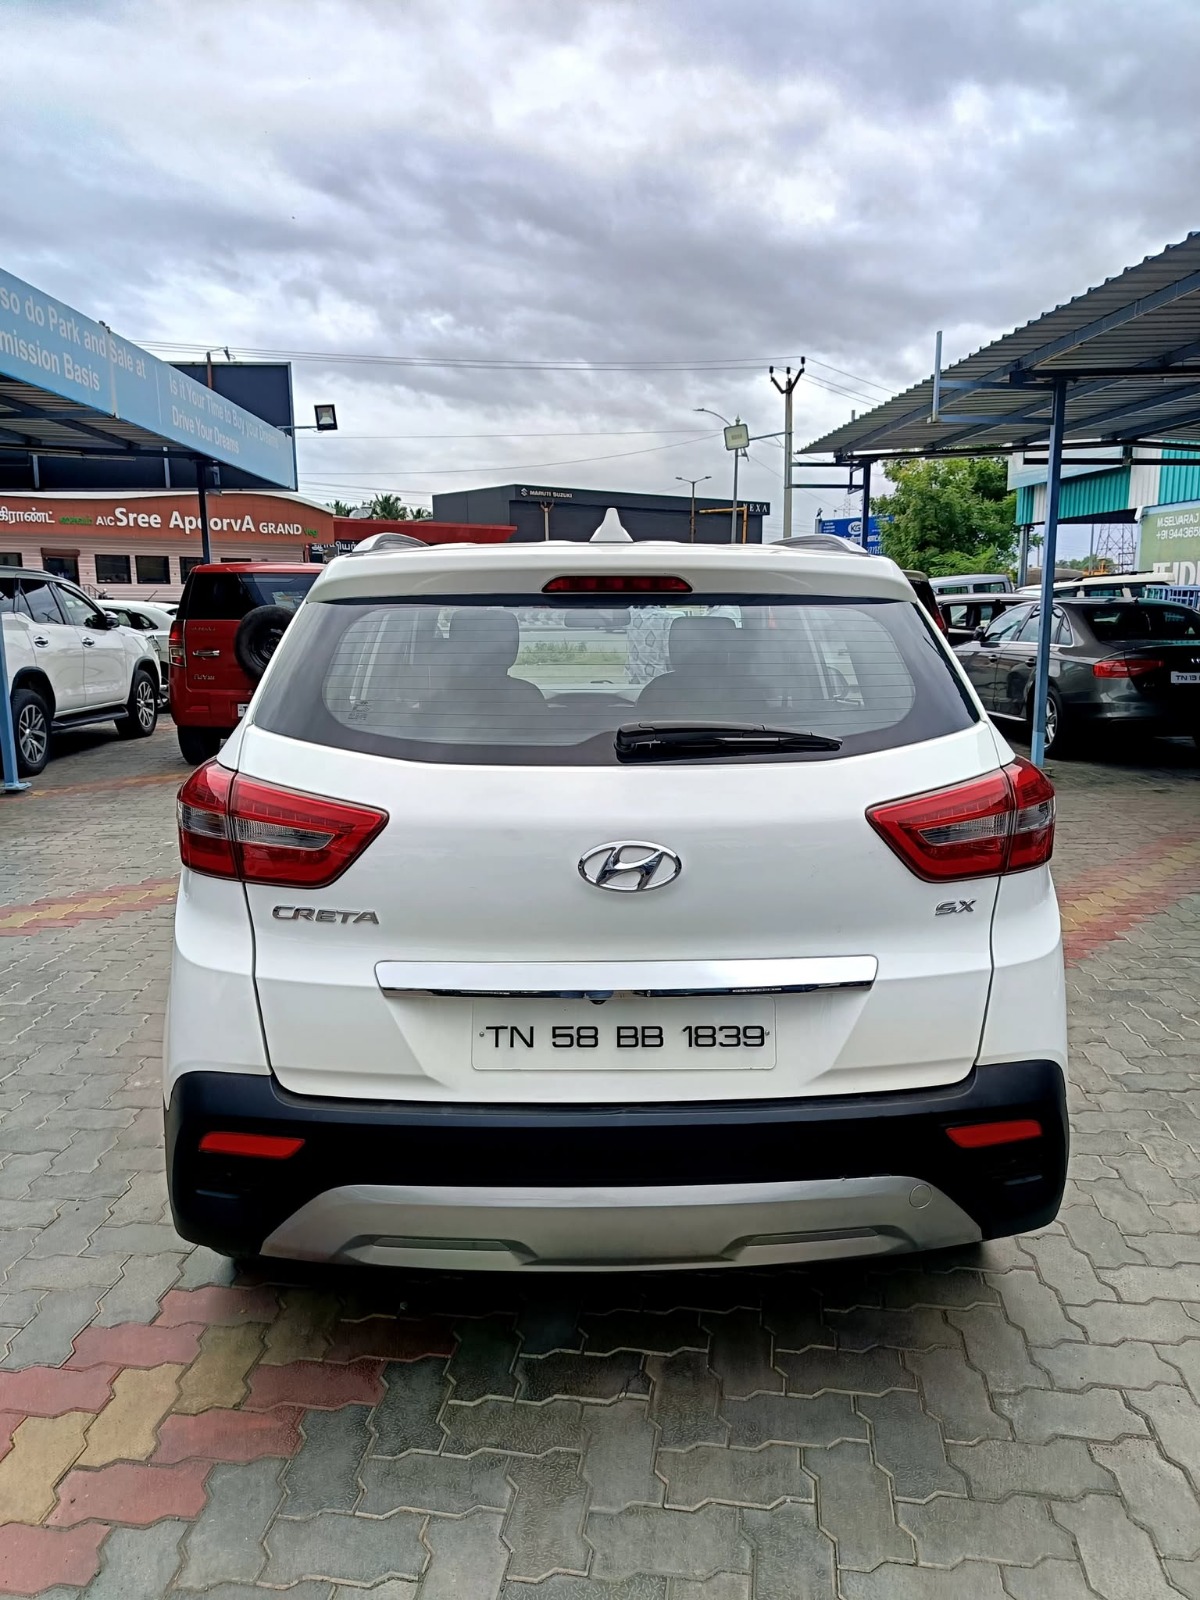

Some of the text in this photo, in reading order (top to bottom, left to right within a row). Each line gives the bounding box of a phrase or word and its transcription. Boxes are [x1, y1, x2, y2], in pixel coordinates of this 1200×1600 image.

[25, 295, 45, 327] do
[48, 305, 80, 345] Park
[84, 330, 107, 358] and
[109, 339, 133, 372] Sale
[135, 358, 146, 379] at
[63, 352, 100, 391] Basis
[169, 373, 178, 396] Is
[179, 379, 186, 402] it
[187, 382, 205, 410] Your
[206, 395, 223, 420] Time
[232, 409, 245, 435] Buy
[171, 405, 240, 454] Drive Your Dreams
[115, 507, 161, 528] Sree
[260, 522, 302, 535] GRAND
[272, 905, 379, 925] CRETA
[935, 900, 977, 916] SX
[486, 1025, 765, 1048] TN 58 BB 1839
